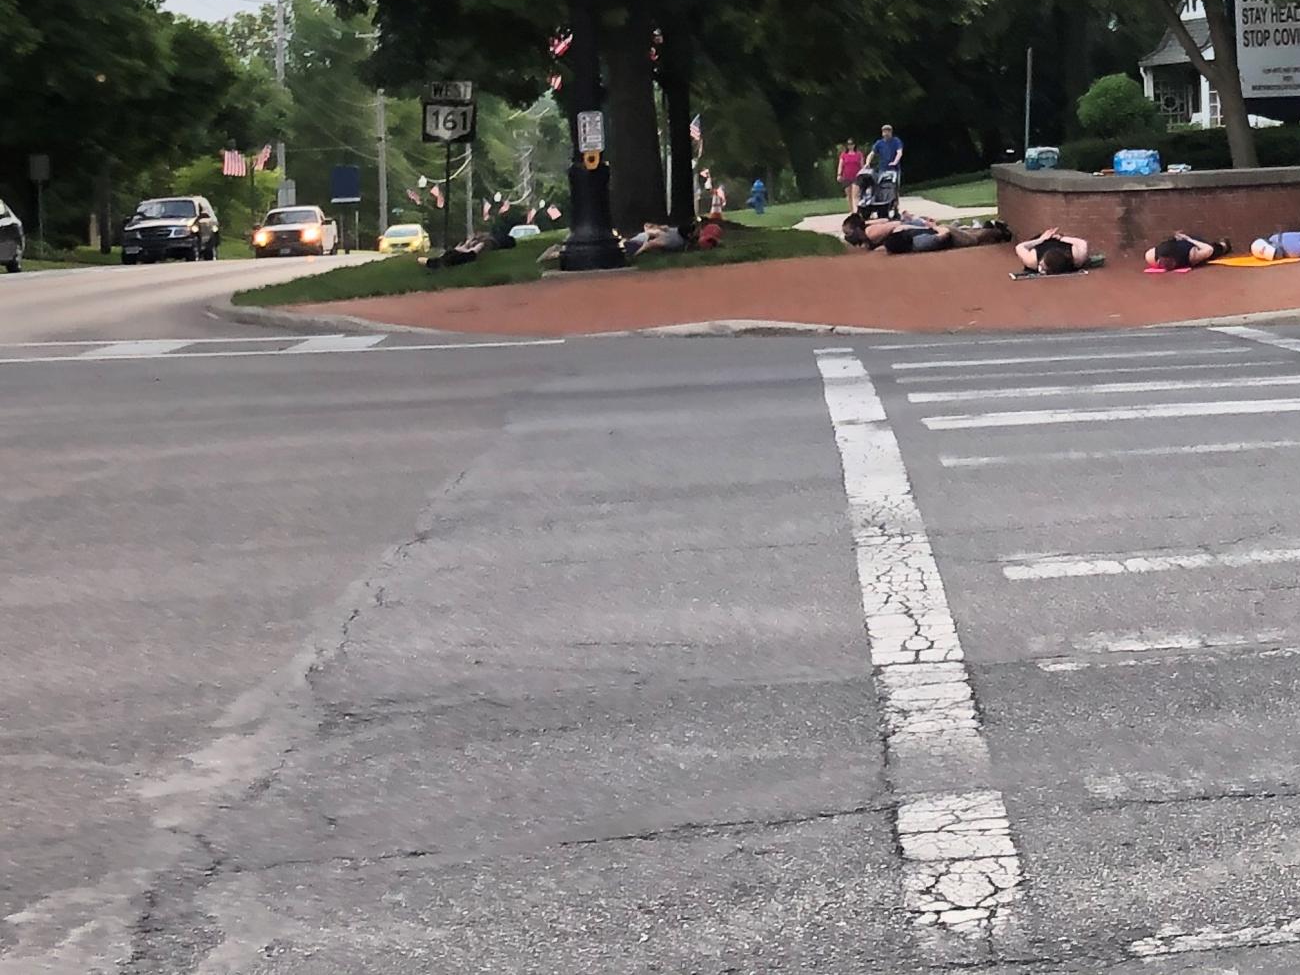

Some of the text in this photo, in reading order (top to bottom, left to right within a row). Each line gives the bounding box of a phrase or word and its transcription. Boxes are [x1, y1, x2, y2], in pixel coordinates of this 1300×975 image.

[1242, 7, 1268, 25] STAY
[1242, 29, 1270, 47] STOP
[432, 84, 470, 97] WEST
[432, 110, 467, 131] 161
